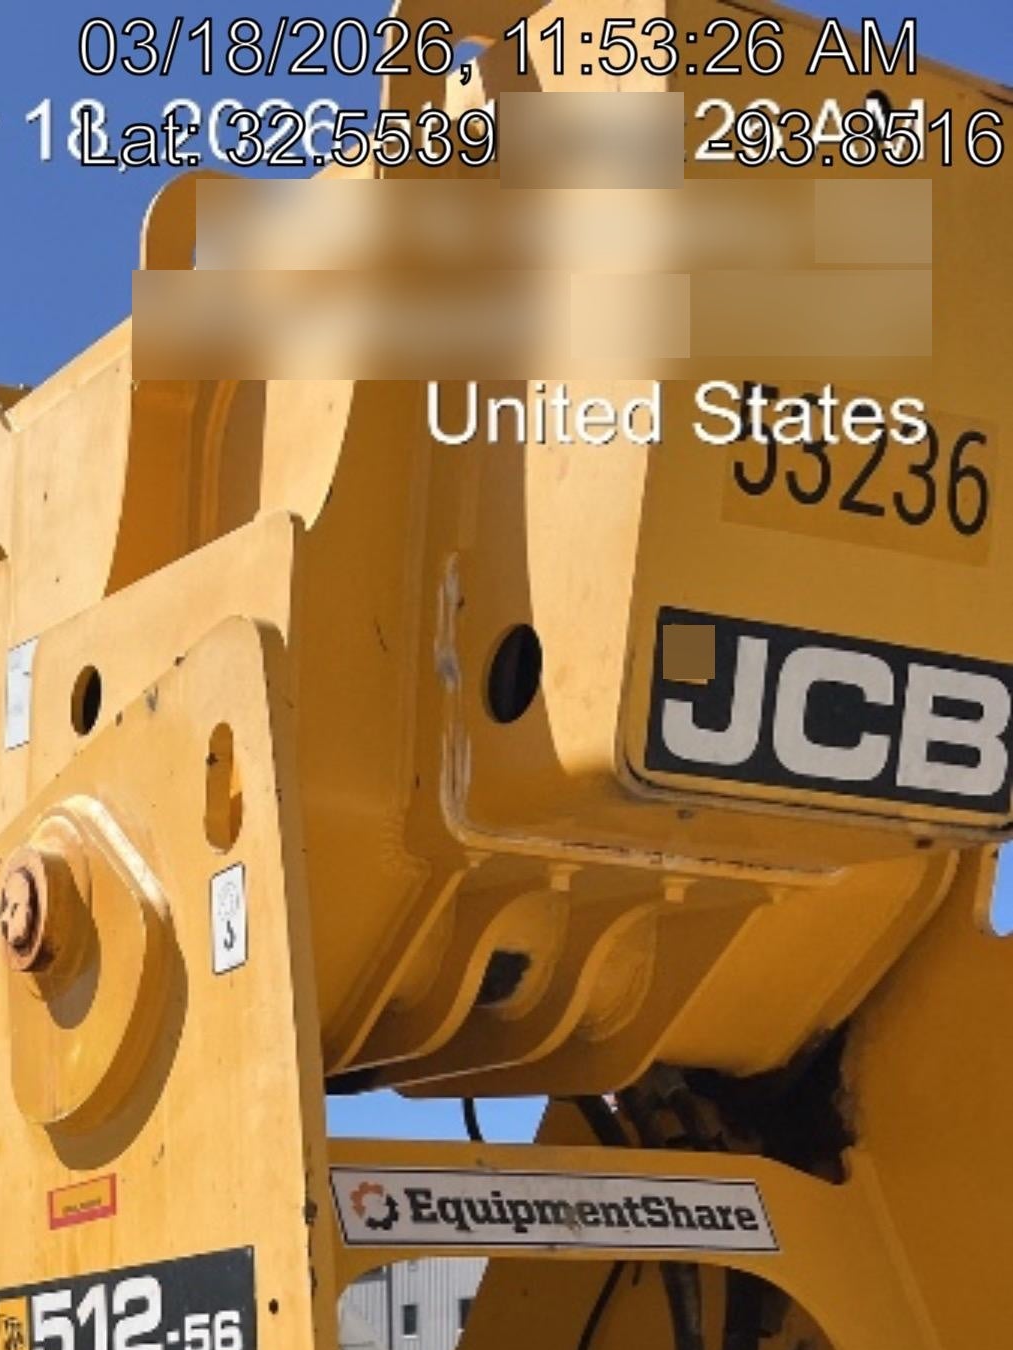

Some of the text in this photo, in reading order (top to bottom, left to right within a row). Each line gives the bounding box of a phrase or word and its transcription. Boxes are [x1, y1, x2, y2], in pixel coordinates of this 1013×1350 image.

[733, 380, 989, 536] 53236
[661, 634, 1012, 797] JCB
[403, 1187, 760, 1234] EquipmentShare
